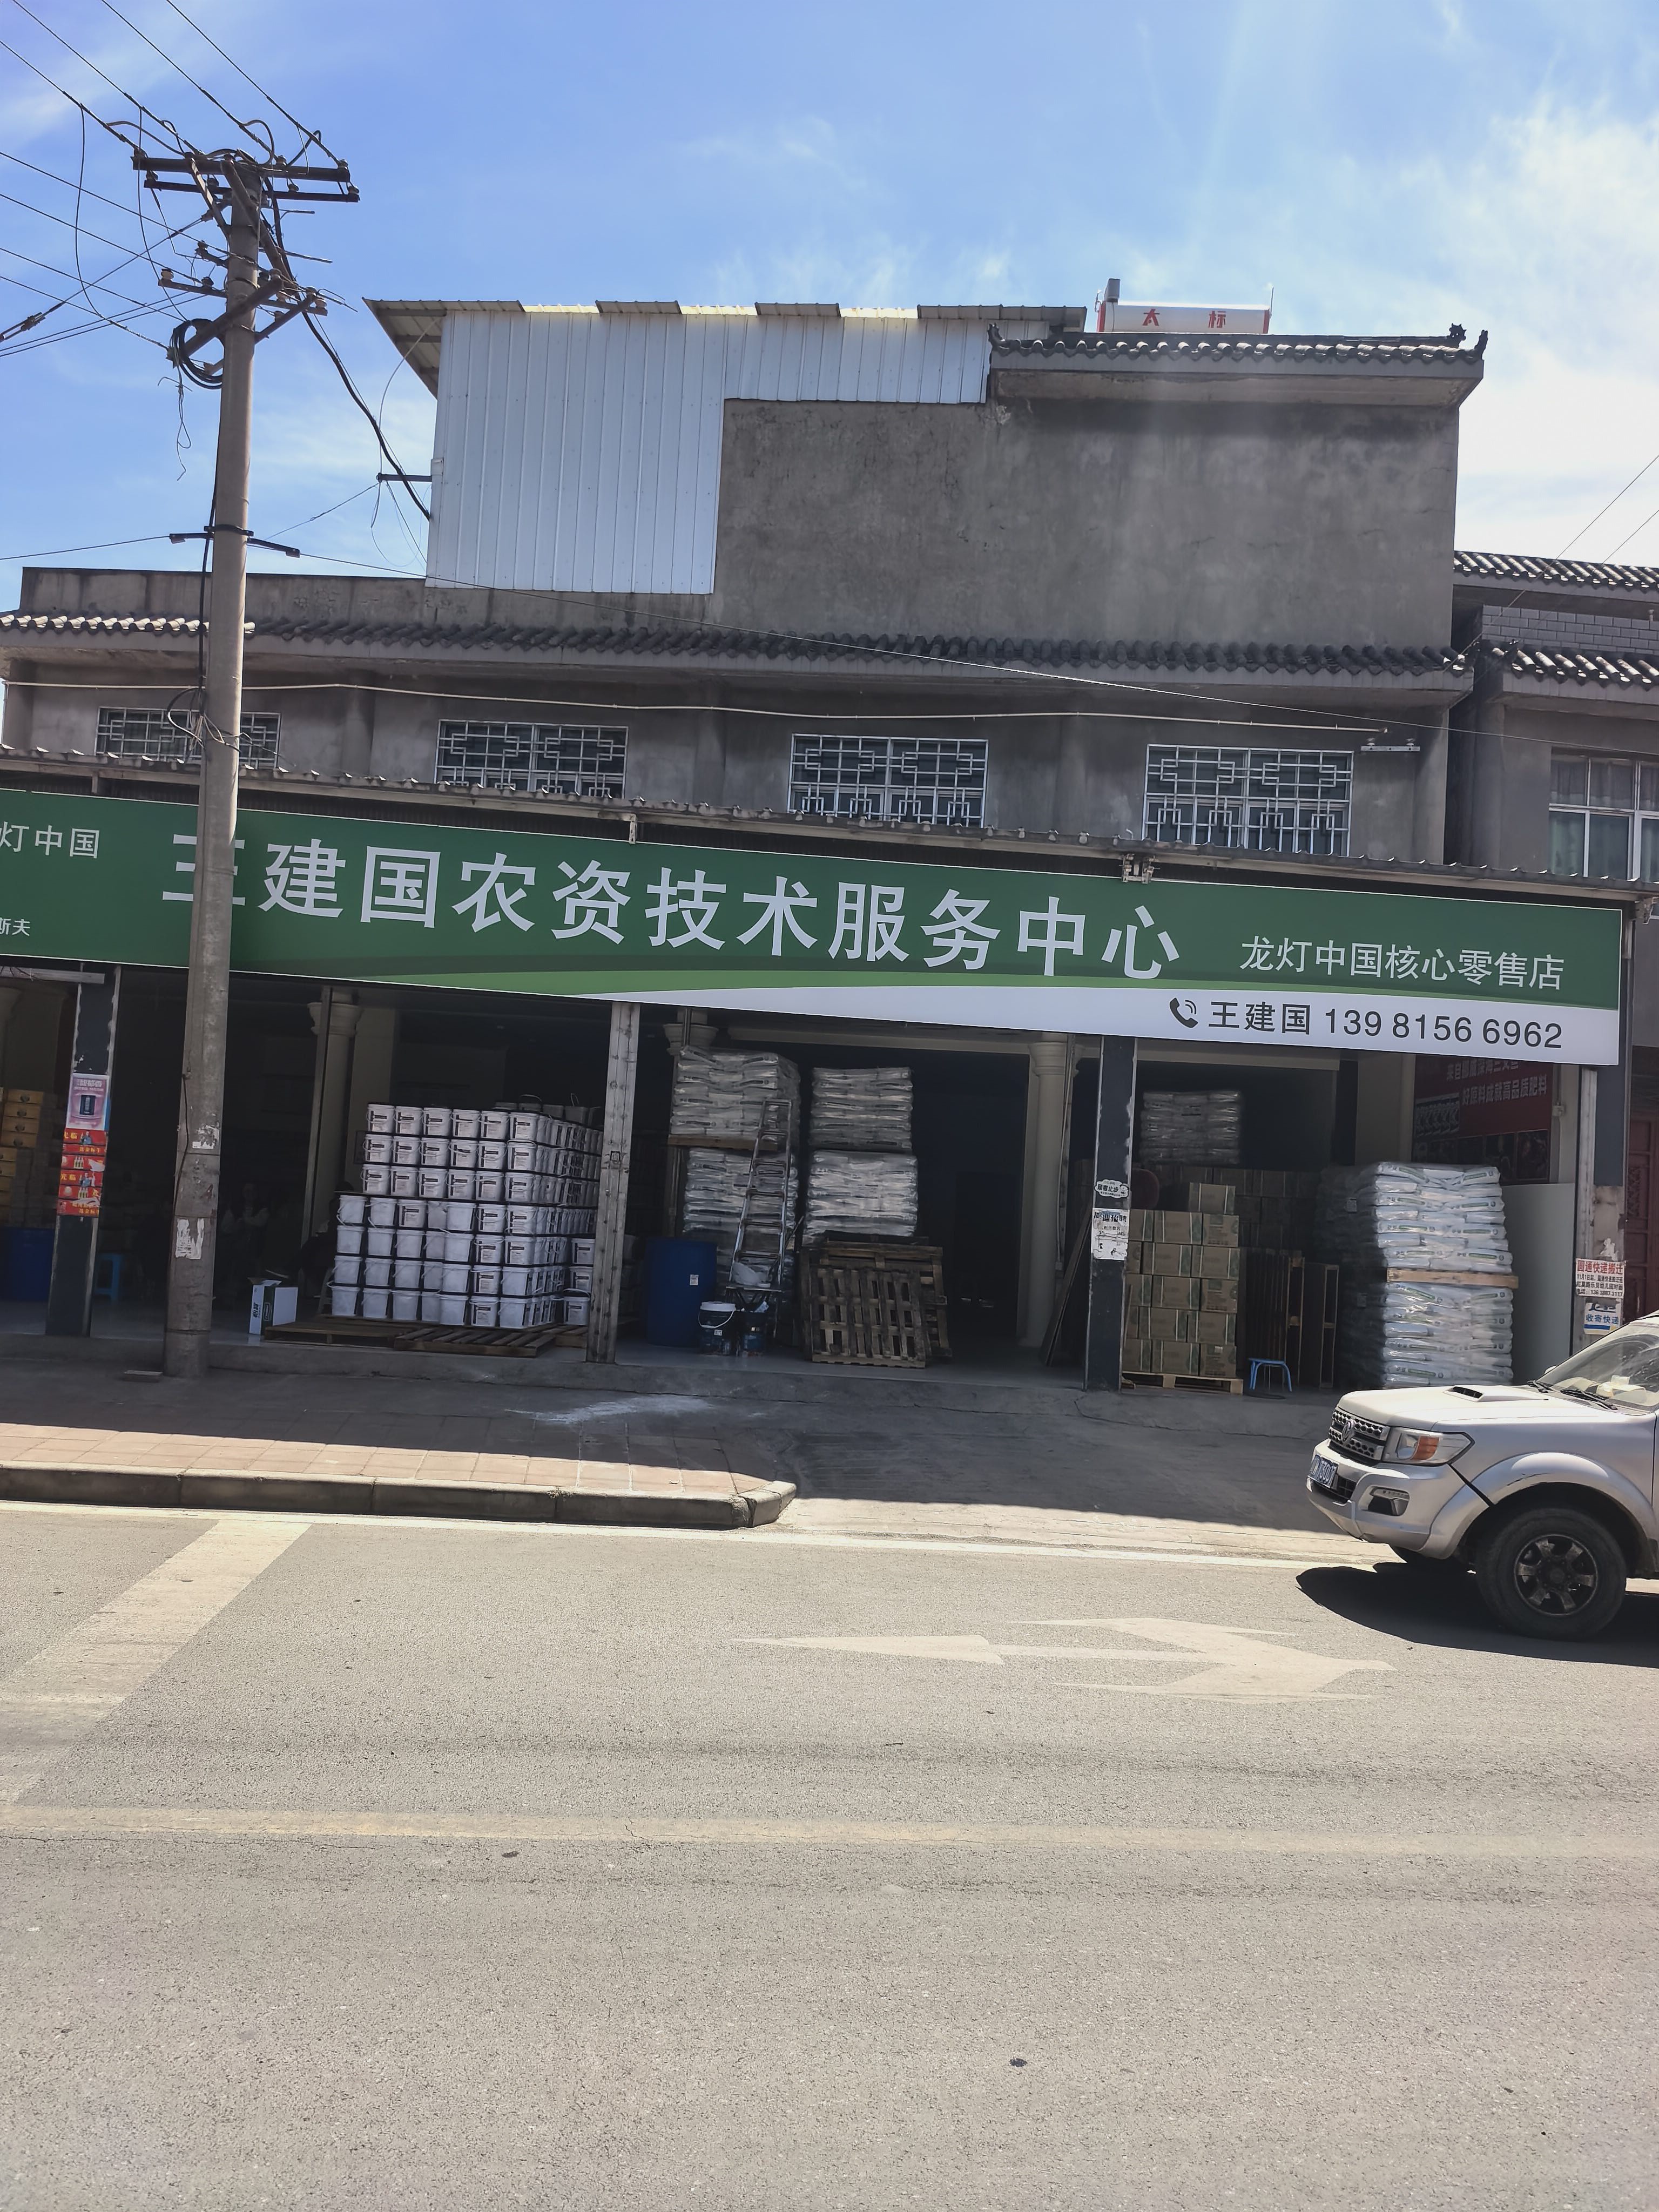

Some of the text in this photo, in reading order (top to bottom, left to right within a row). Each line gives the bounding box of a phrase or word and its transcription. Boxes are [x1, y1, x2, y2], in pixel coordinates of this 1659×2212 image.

[0, 821, 100, 859] 灯中国
[1240, 935, 1564, 990] 龙灯中国核心零售店
[1208, 1001, 1562, 1049] 王建国 139 8156 6962
[1577, 1260, 1623, 1275] 圆通快递搬迁
[1586, 1313, 1619, 1325] 收寄快递
